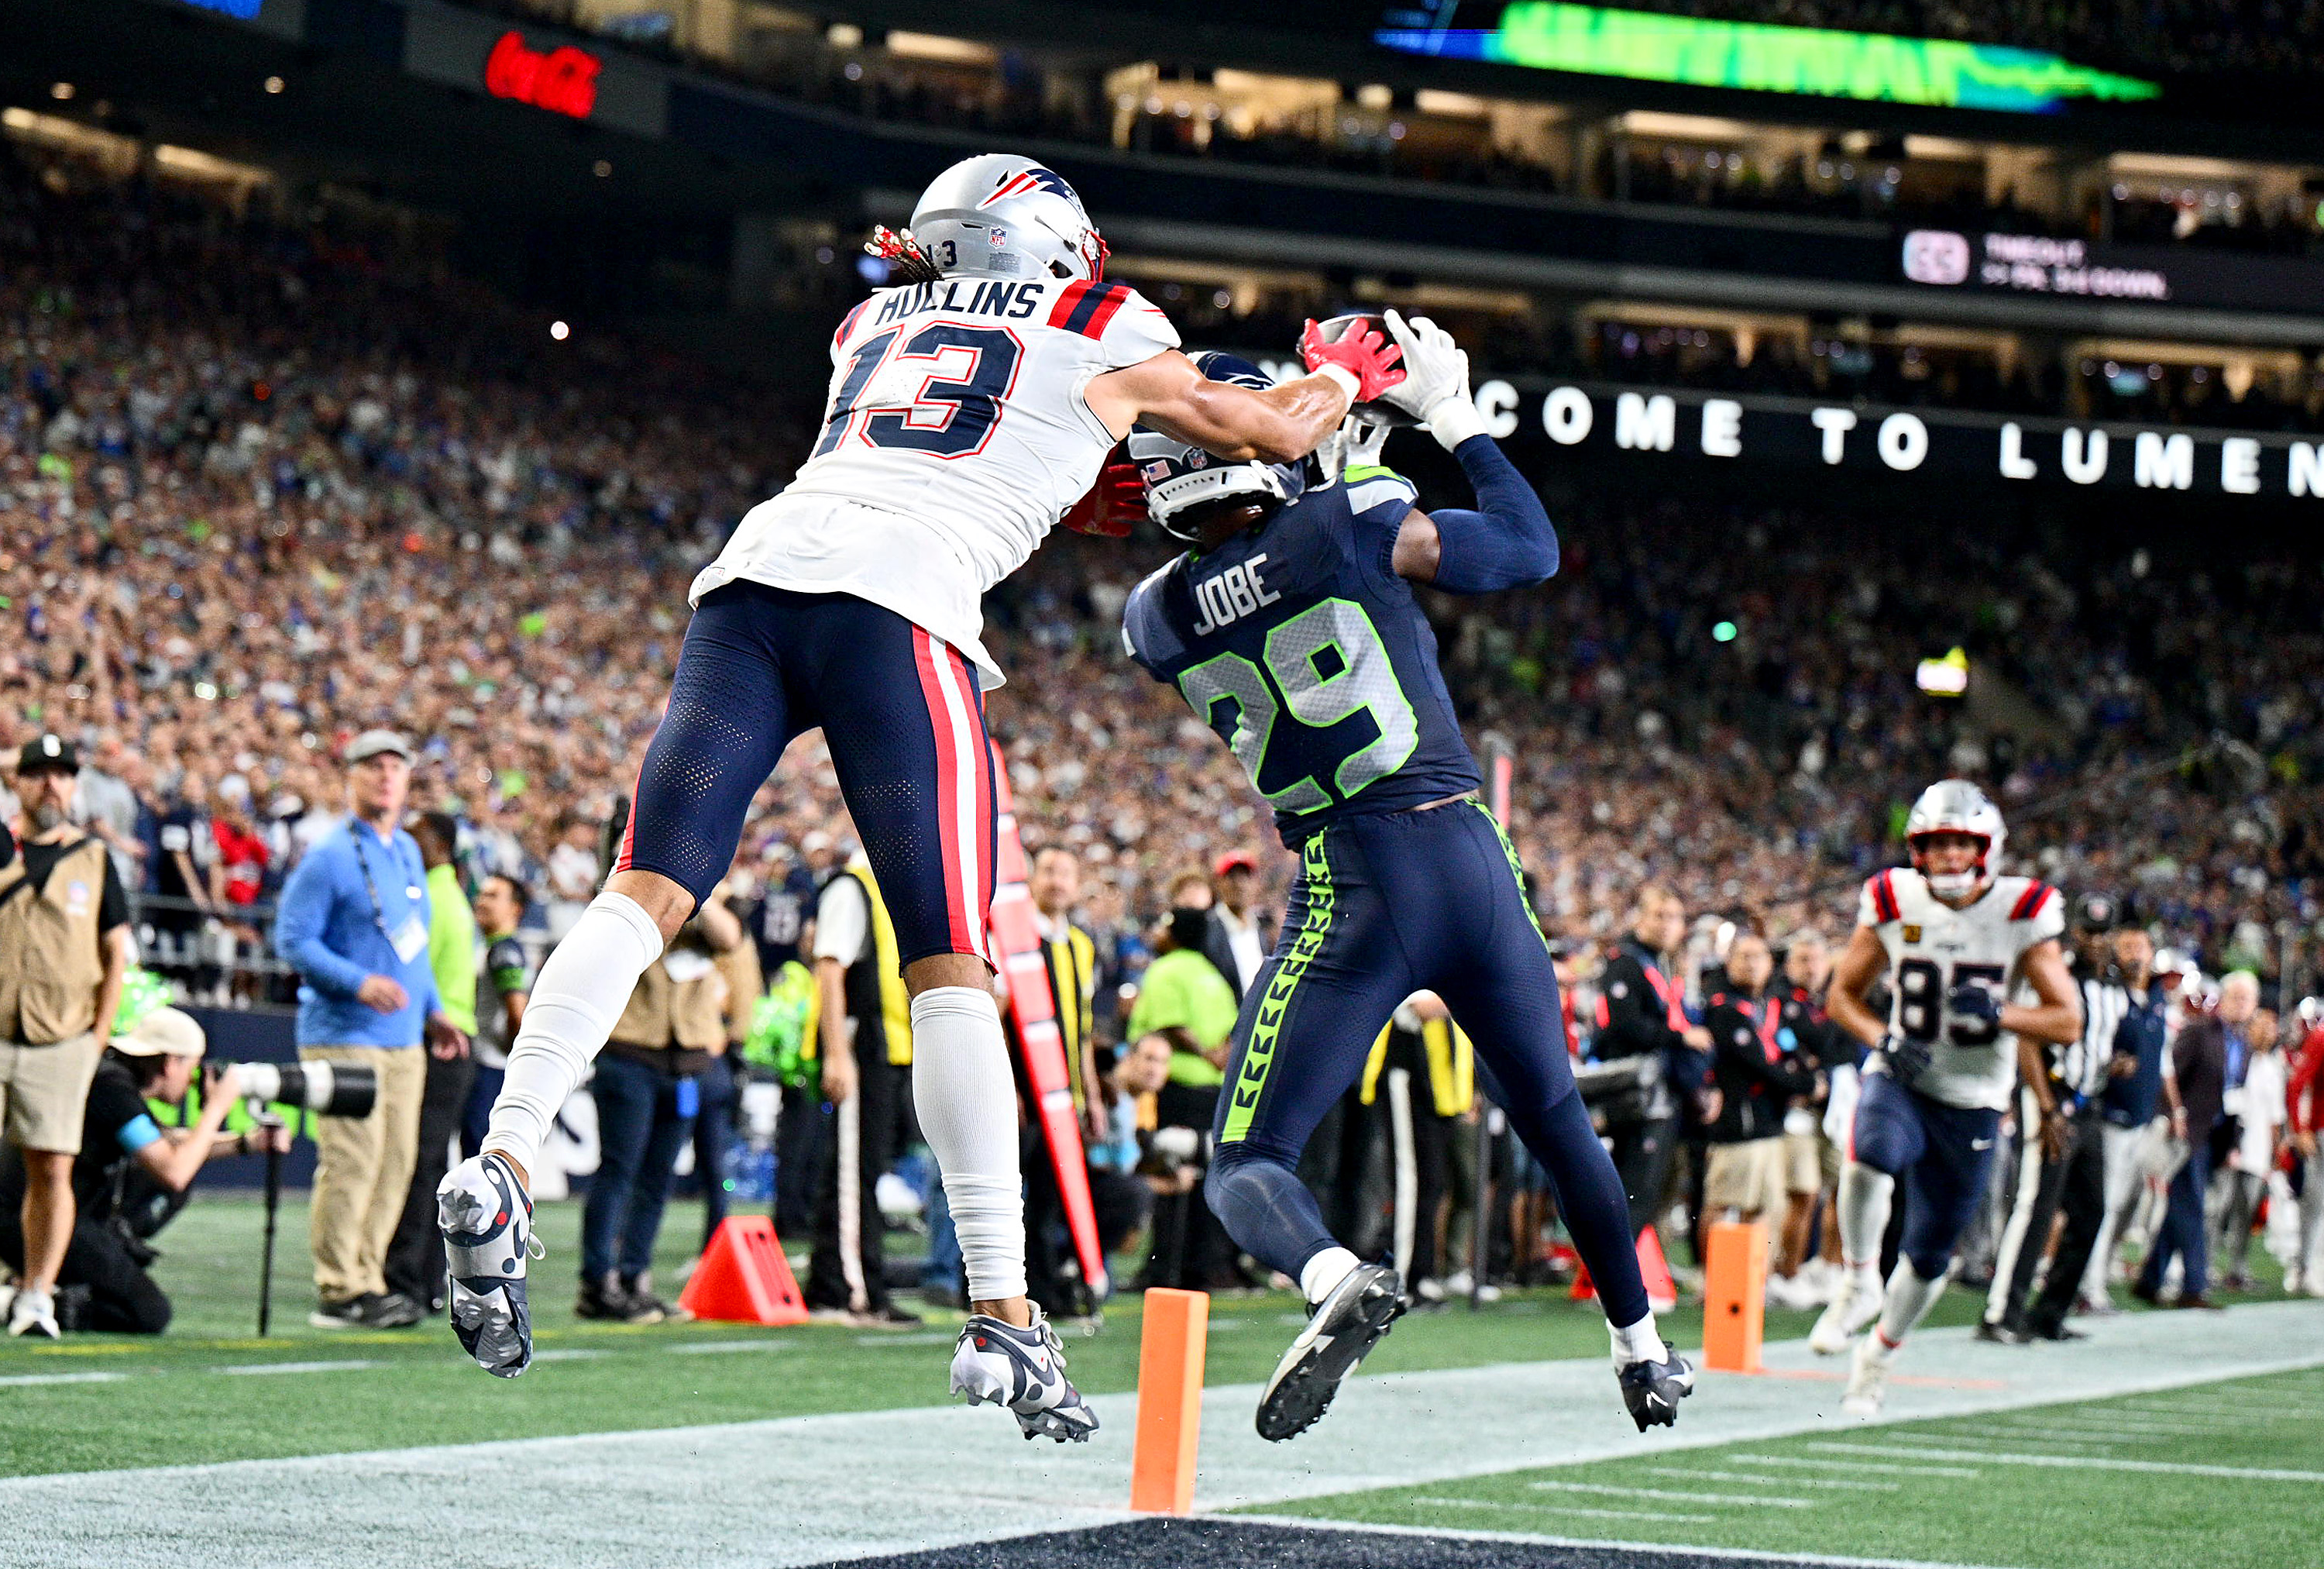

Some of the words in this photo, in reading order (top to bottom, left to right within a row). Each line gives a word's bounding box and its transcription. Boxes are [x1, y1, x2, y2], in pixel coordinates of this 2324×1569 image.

[991, 235, 1006, 246] NFL
[812, 320, 1026, 460] 13
[1811, 407, 1929, 471] TO
[1193, 552, 1281, 637] JOBE
[1177, 596, 1419, 816] 29
[1898, 958, 2006, 1047] 85
